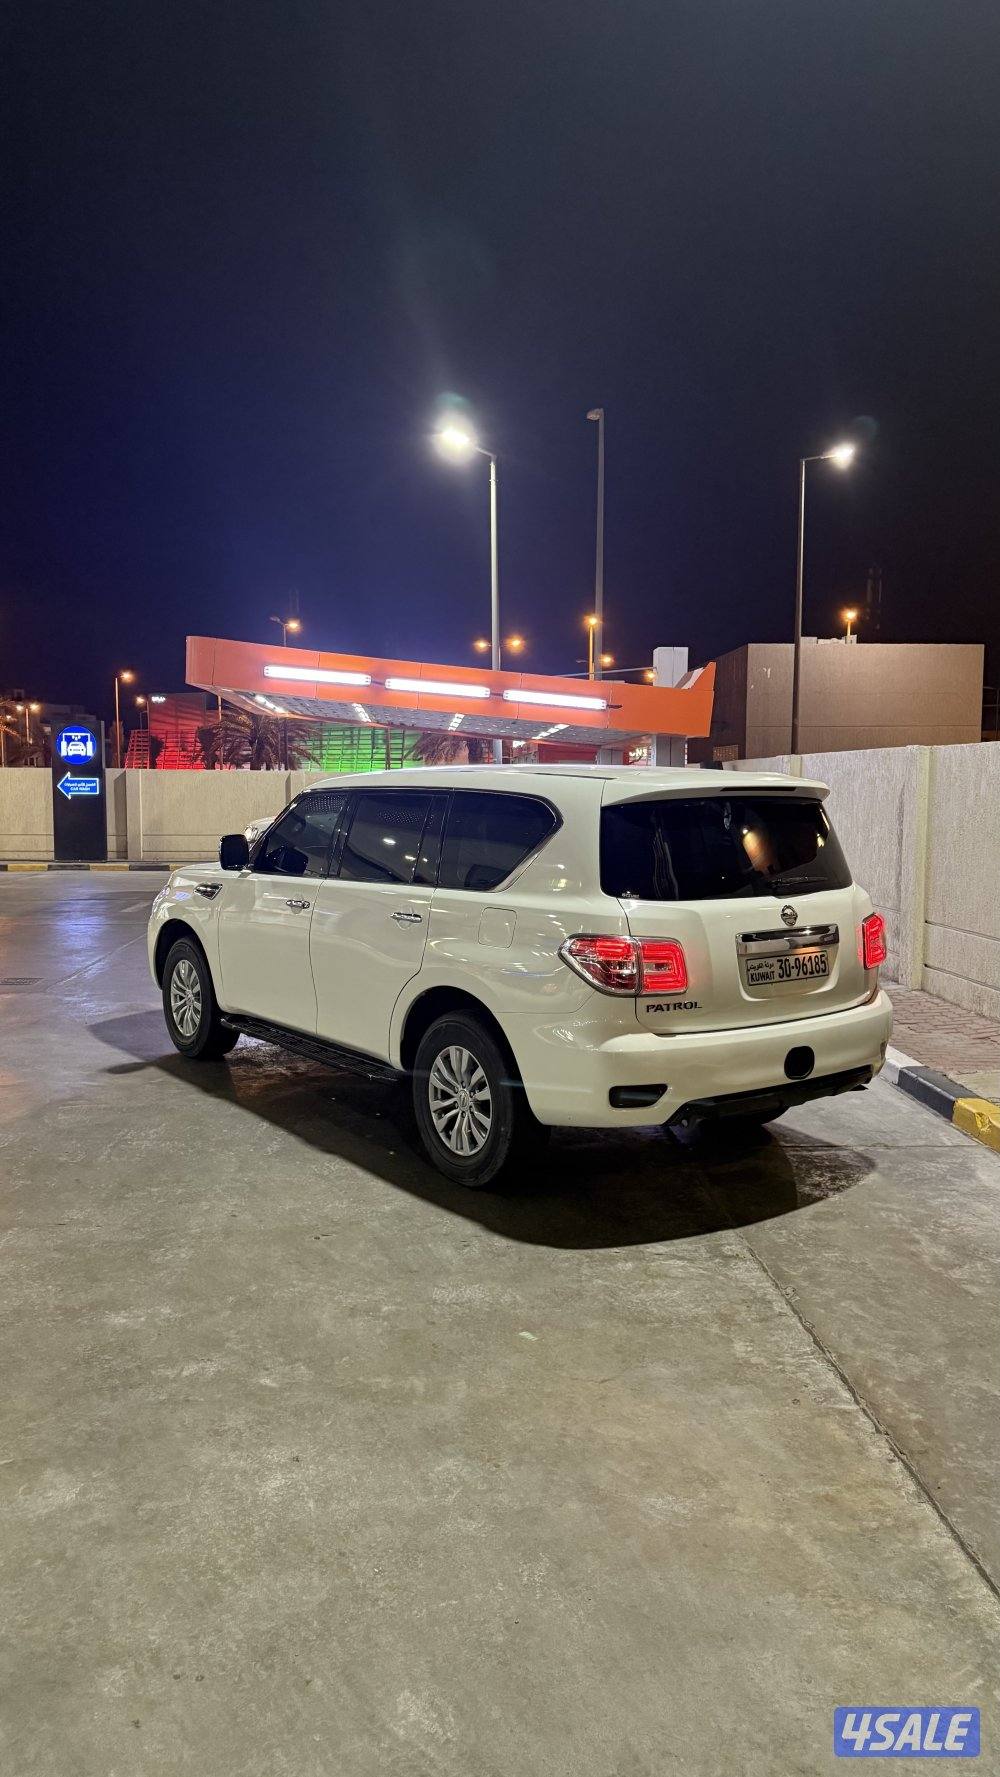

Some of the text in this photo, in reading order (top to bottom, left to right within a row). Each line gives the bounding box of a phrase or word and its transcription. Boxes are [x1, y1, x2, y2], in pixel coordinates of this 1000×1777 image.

[777, 954, 827, 978] 30-96185
[750, 970, 775, 982] KUWAIT
[646, 1001, 703, 1013] PATROL
